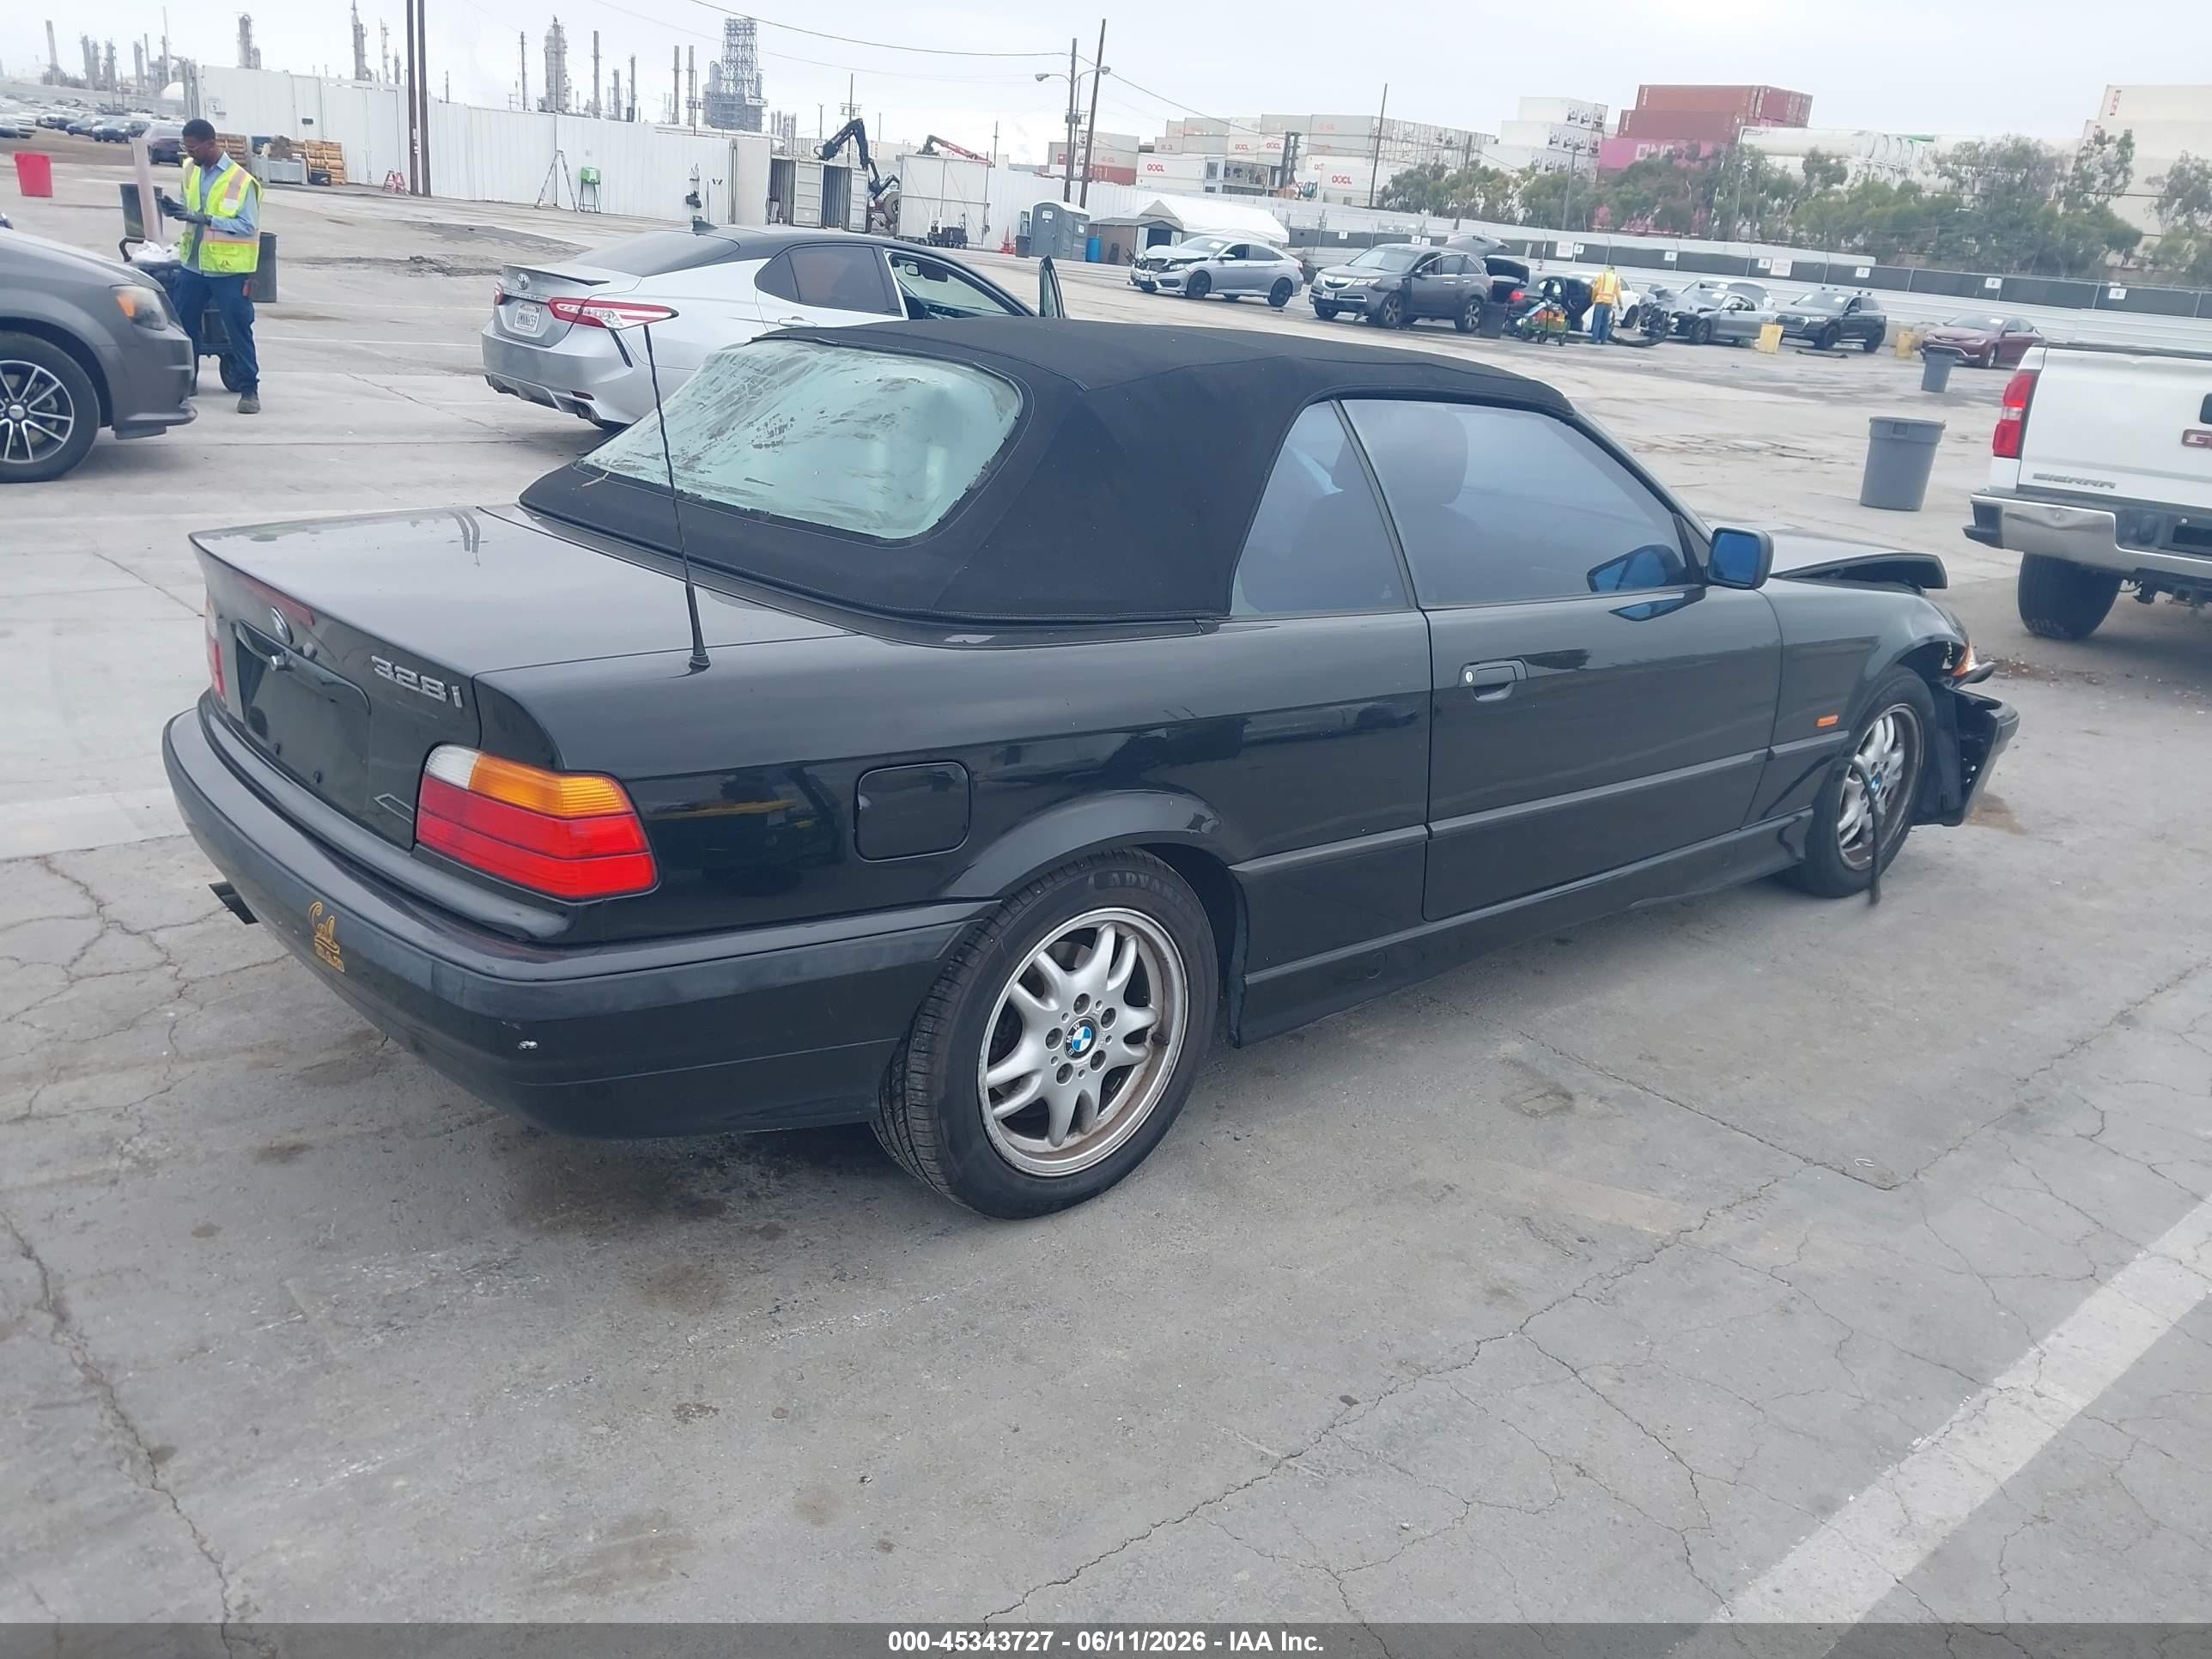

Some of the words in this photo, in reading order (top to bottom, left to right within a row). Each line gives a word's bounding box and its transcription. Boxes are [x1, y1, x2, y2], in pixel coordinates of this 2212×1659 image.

[1146, 163, 1165, 172] OOCL
[1332, 175, 1352, 185] OOCL
[2033, 472, 2116, 489] SIERRA
[370, 655, 463, 708] 328i
